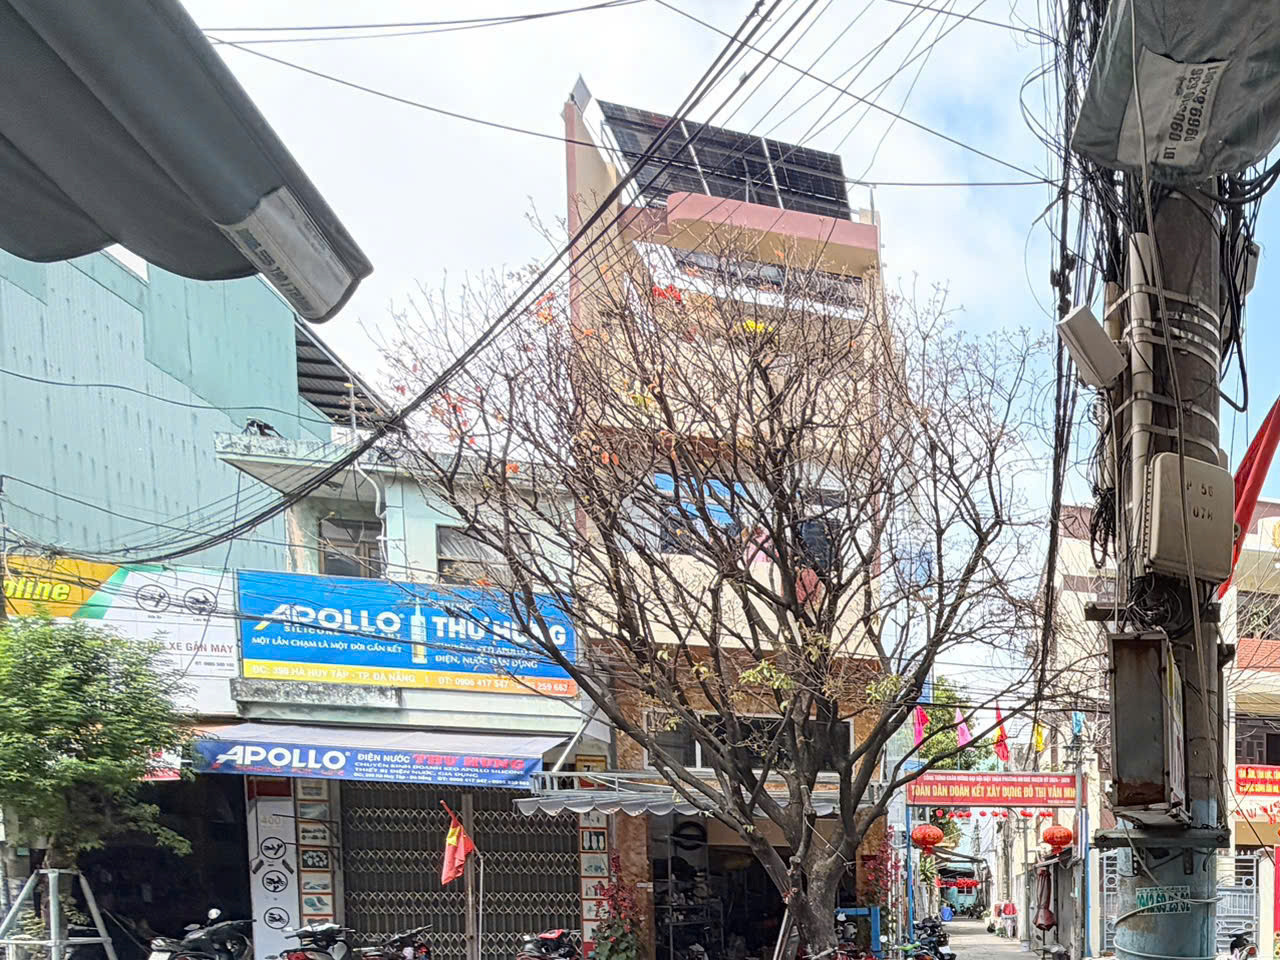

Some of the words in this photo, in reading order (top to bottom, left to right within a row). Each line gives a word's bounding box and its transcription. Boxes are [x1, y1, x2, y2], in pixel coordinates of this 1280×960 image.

[254, 603, 402, 633] APOLLO
[169, 642, 183, 651] XE
[211, 745, 346, 770] APOLLO
[911, 782, 931, 797] TOÀN
[932, 782, 948, 797] DÂN
[971, 782, 985, 797] KẾT
[986, 783, 1000, 798] XÂY
